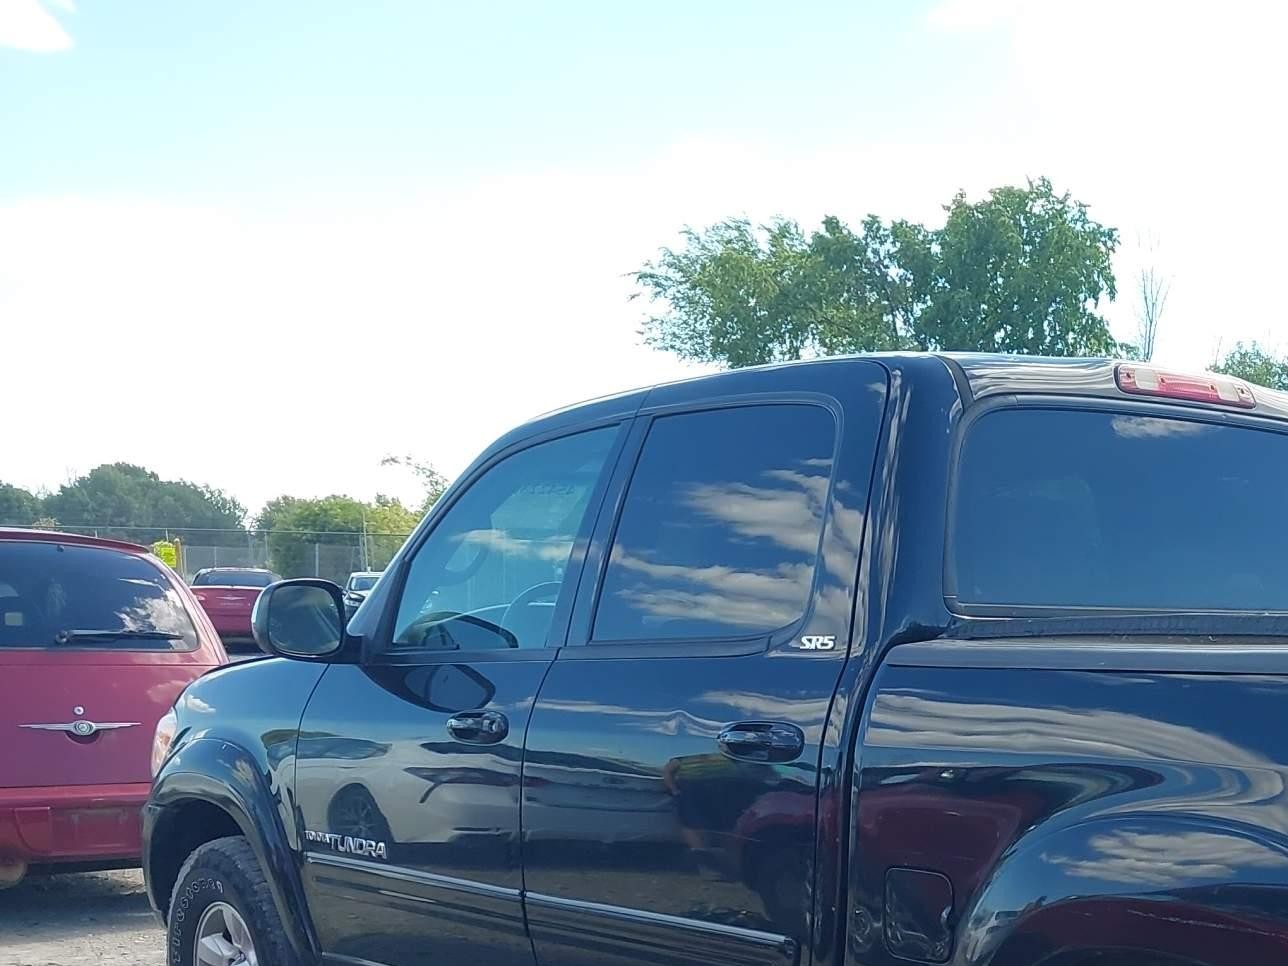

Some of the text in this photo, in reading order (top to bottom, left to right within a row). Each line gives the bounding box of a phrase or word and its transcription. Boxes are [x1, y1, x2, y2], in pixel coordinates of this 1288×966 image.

[800, 636, 835, 650] SR5
[304, 830, 388, 860] TOYOTA TUNDRA
